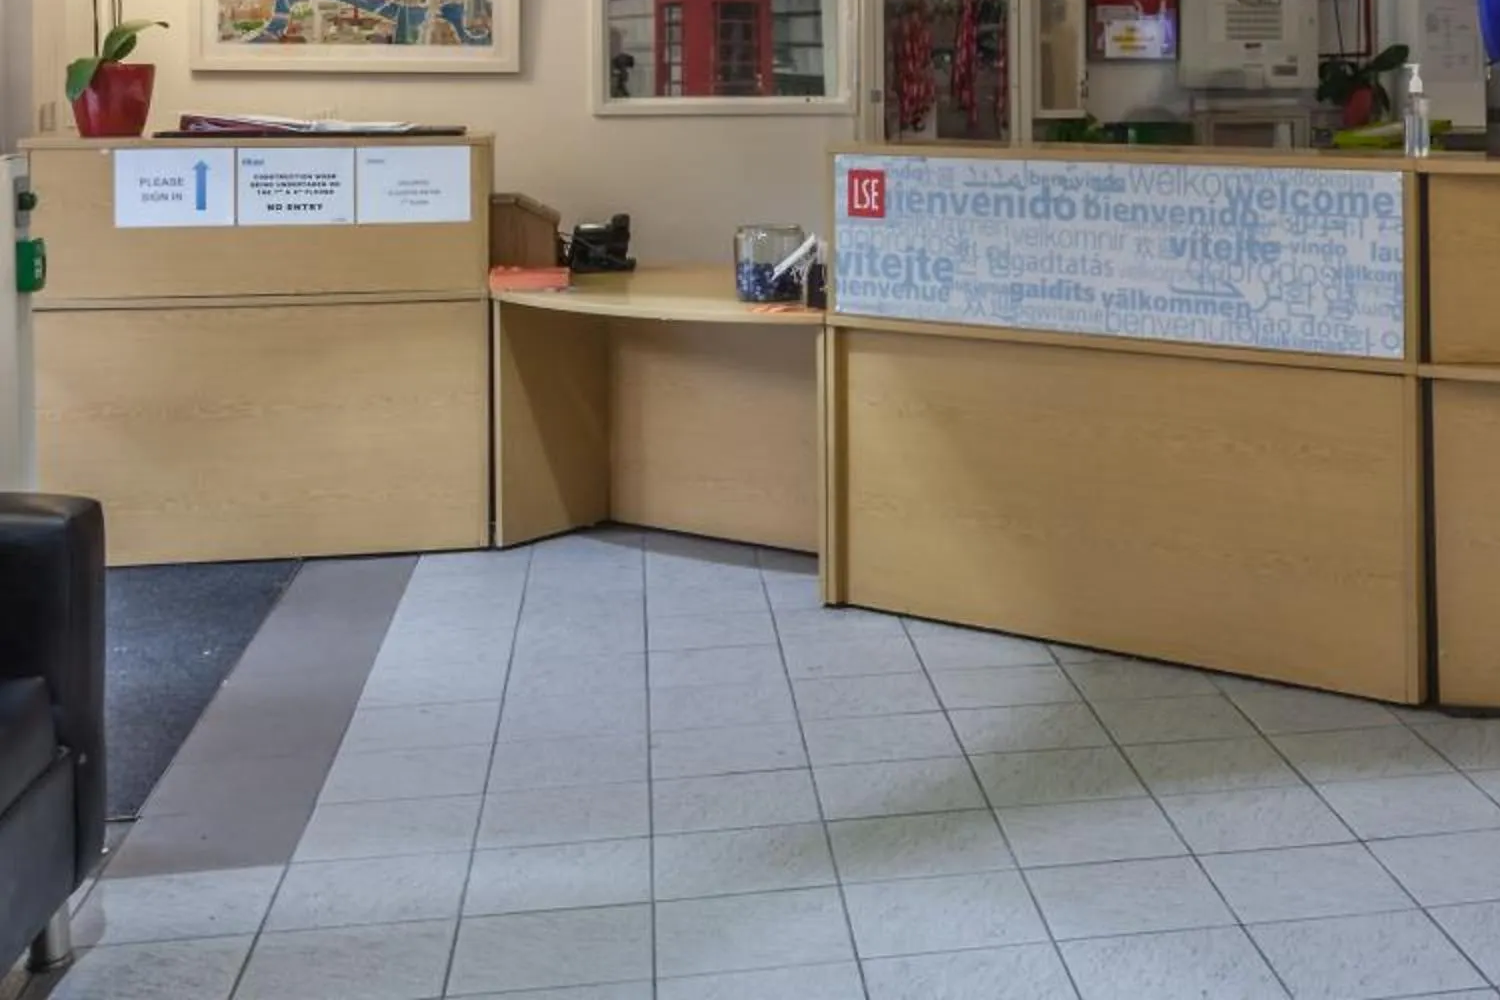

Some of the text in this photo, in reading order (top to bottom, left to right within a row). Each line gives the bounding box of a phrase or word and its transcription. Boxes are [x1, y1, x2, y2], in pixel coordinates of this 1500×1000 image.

[138, 176, 185, 189] PLEASE
[140, 190, 184, 202] SIGN IN
[852, 178, 880, 211] LSE
[886, 184, 1077, 221] ienvenido
[1226, 181, 1395, 218] welcome
[266, 202, 324, 211] NO ENTRY
